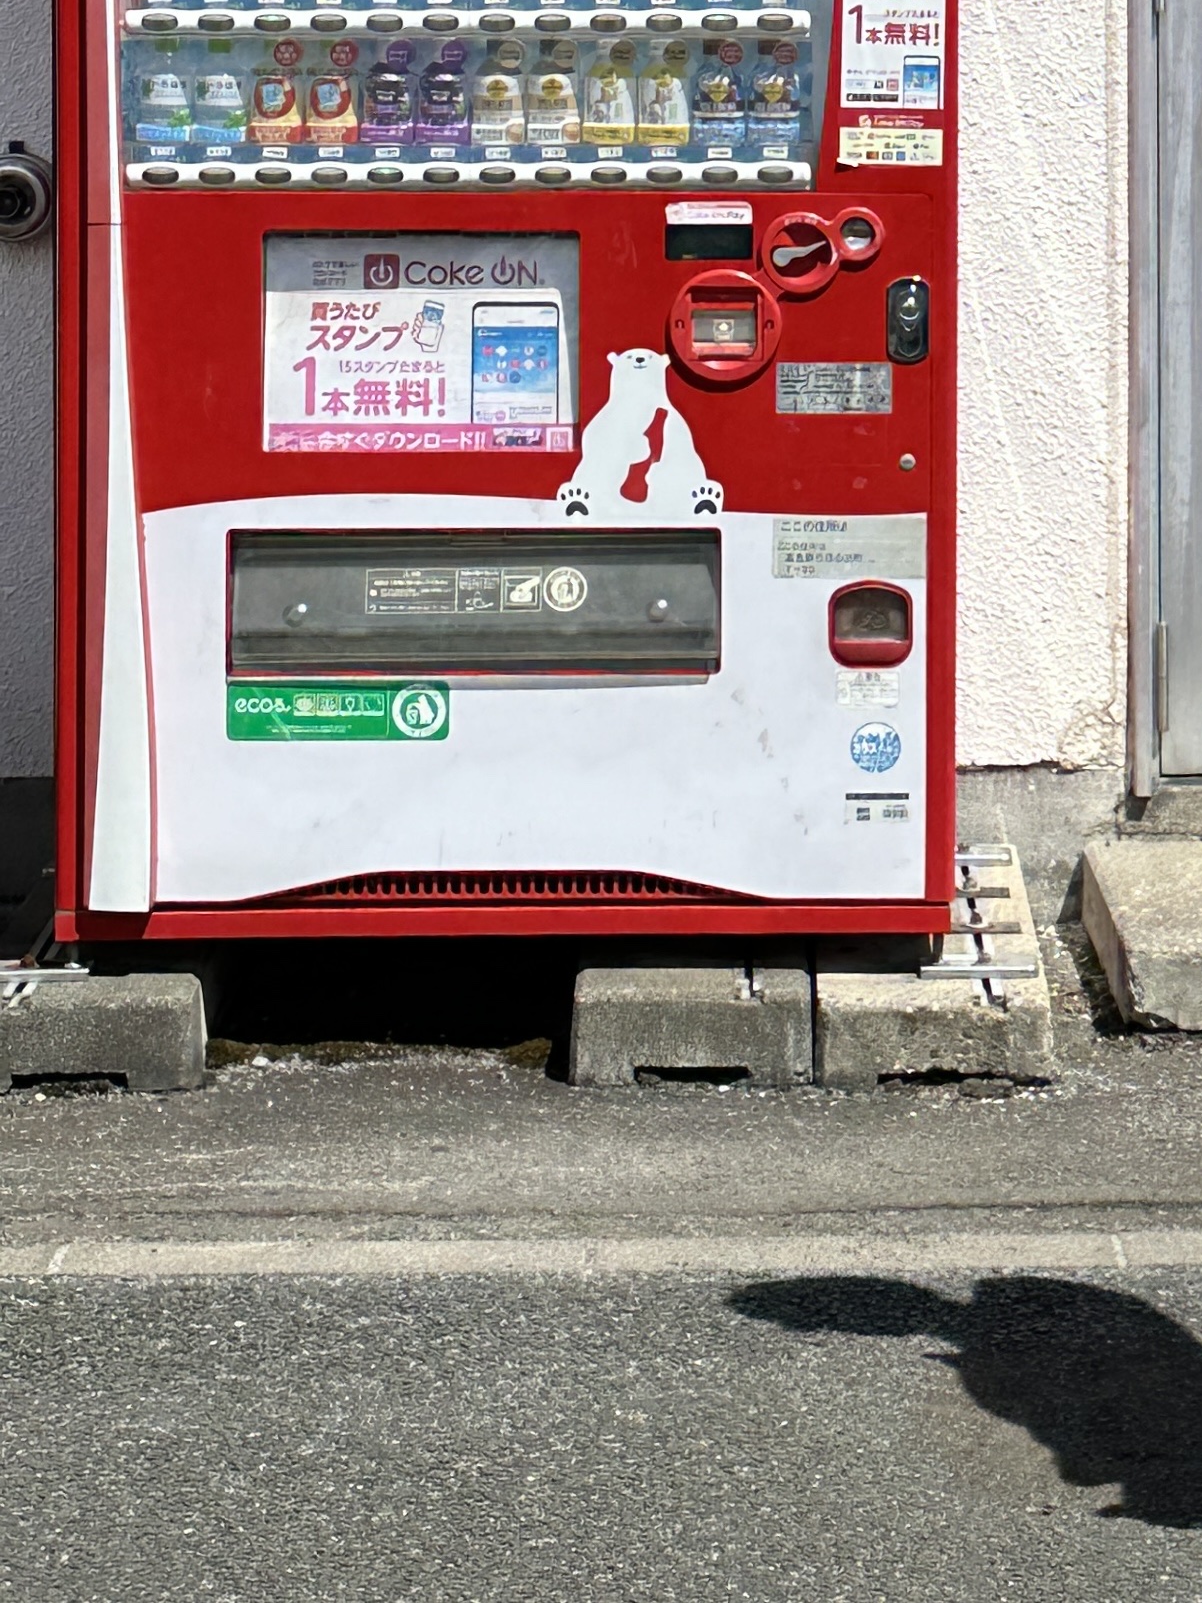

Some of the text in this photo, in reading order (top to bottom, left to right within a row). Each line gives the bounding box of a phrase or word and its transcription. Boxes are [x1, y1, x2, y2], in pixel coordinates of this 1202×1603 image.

[404, 255, 538, 286] Coke ON
[310, 301, 382, 322] 買うたび
[305, 322, 410, 352] スタンプ
[292, 356, 446, 417] 1本無料!
